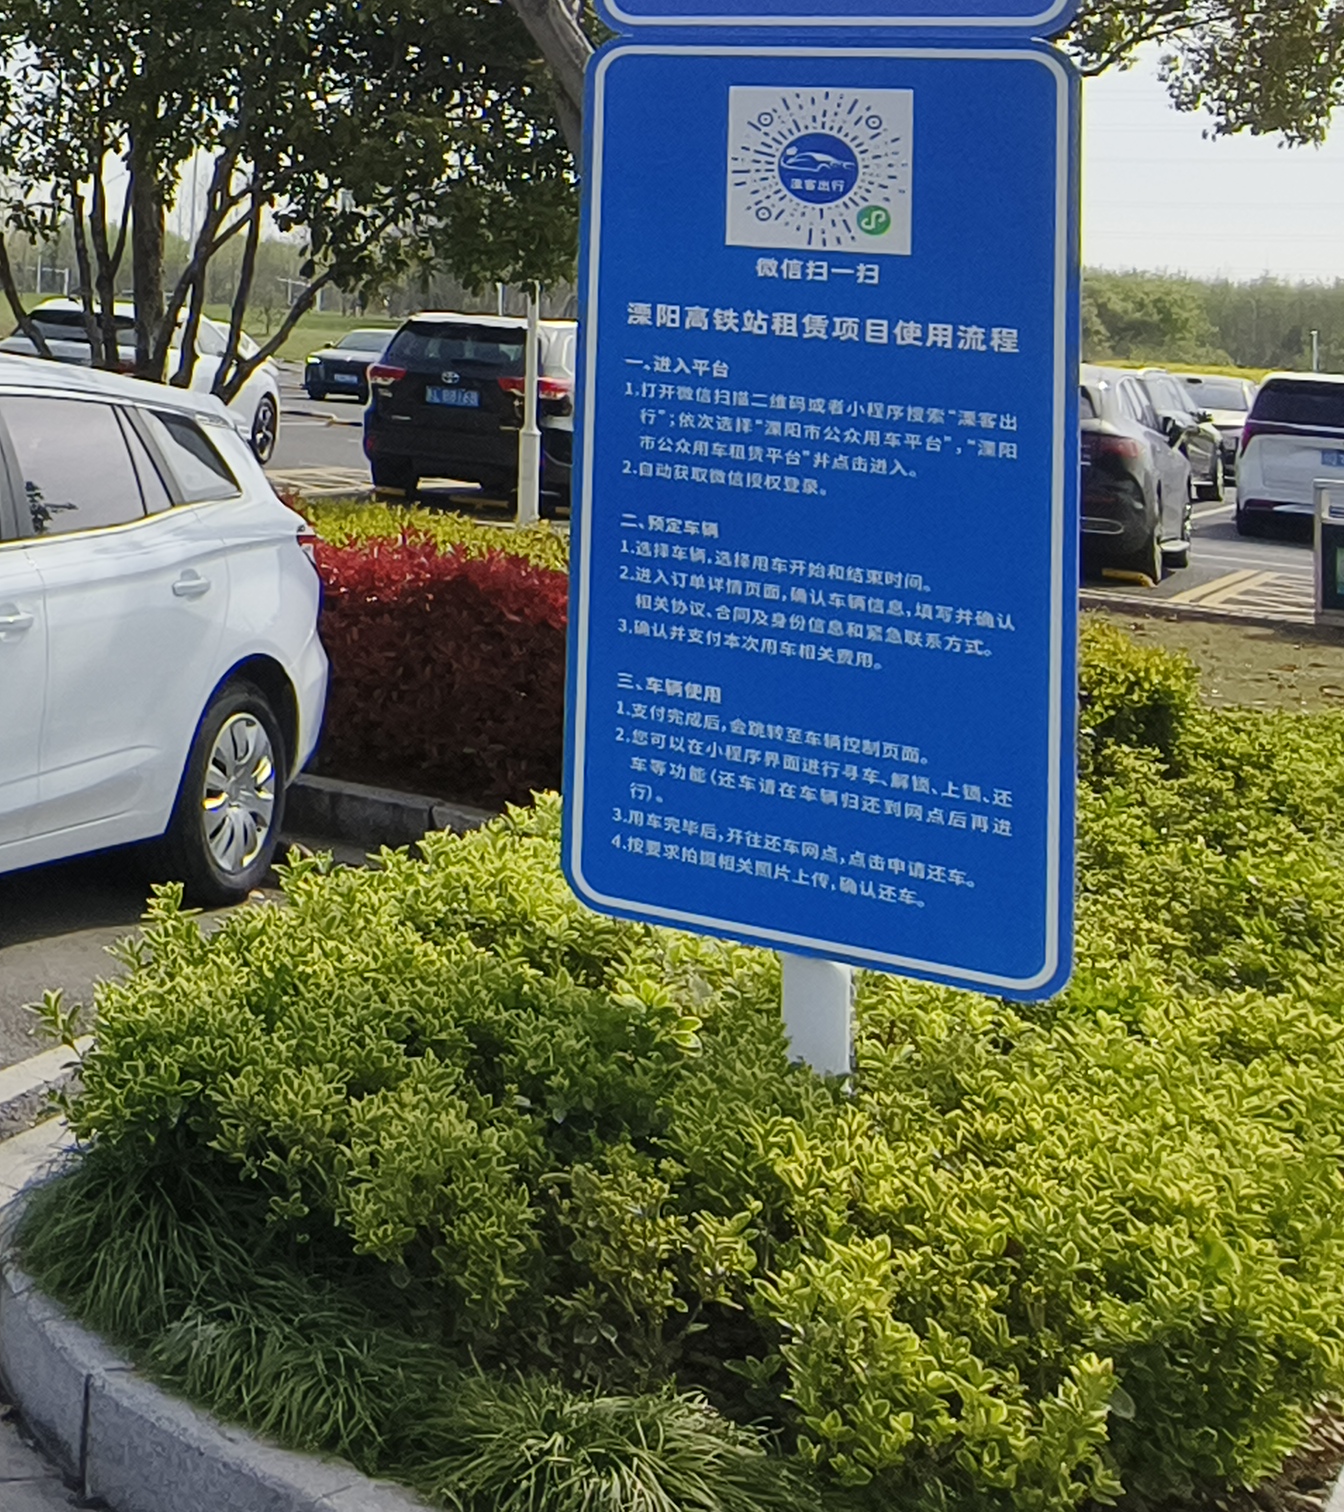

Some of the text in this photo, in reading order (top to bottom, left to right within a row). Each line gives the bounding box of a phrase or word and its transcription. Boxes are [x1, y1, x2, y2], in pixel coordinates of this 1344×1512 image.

[755, 257, 880, 285] 微信扫一扫
[626, 301, 1020, 354] 溧阳高铁站租赁项目使用流程
[624, 355, 730, 378] 一、进入平台
[619, 513, 720, 538] 二、预定车辆
[616, 672, 722, 705] 三、车辆使用
